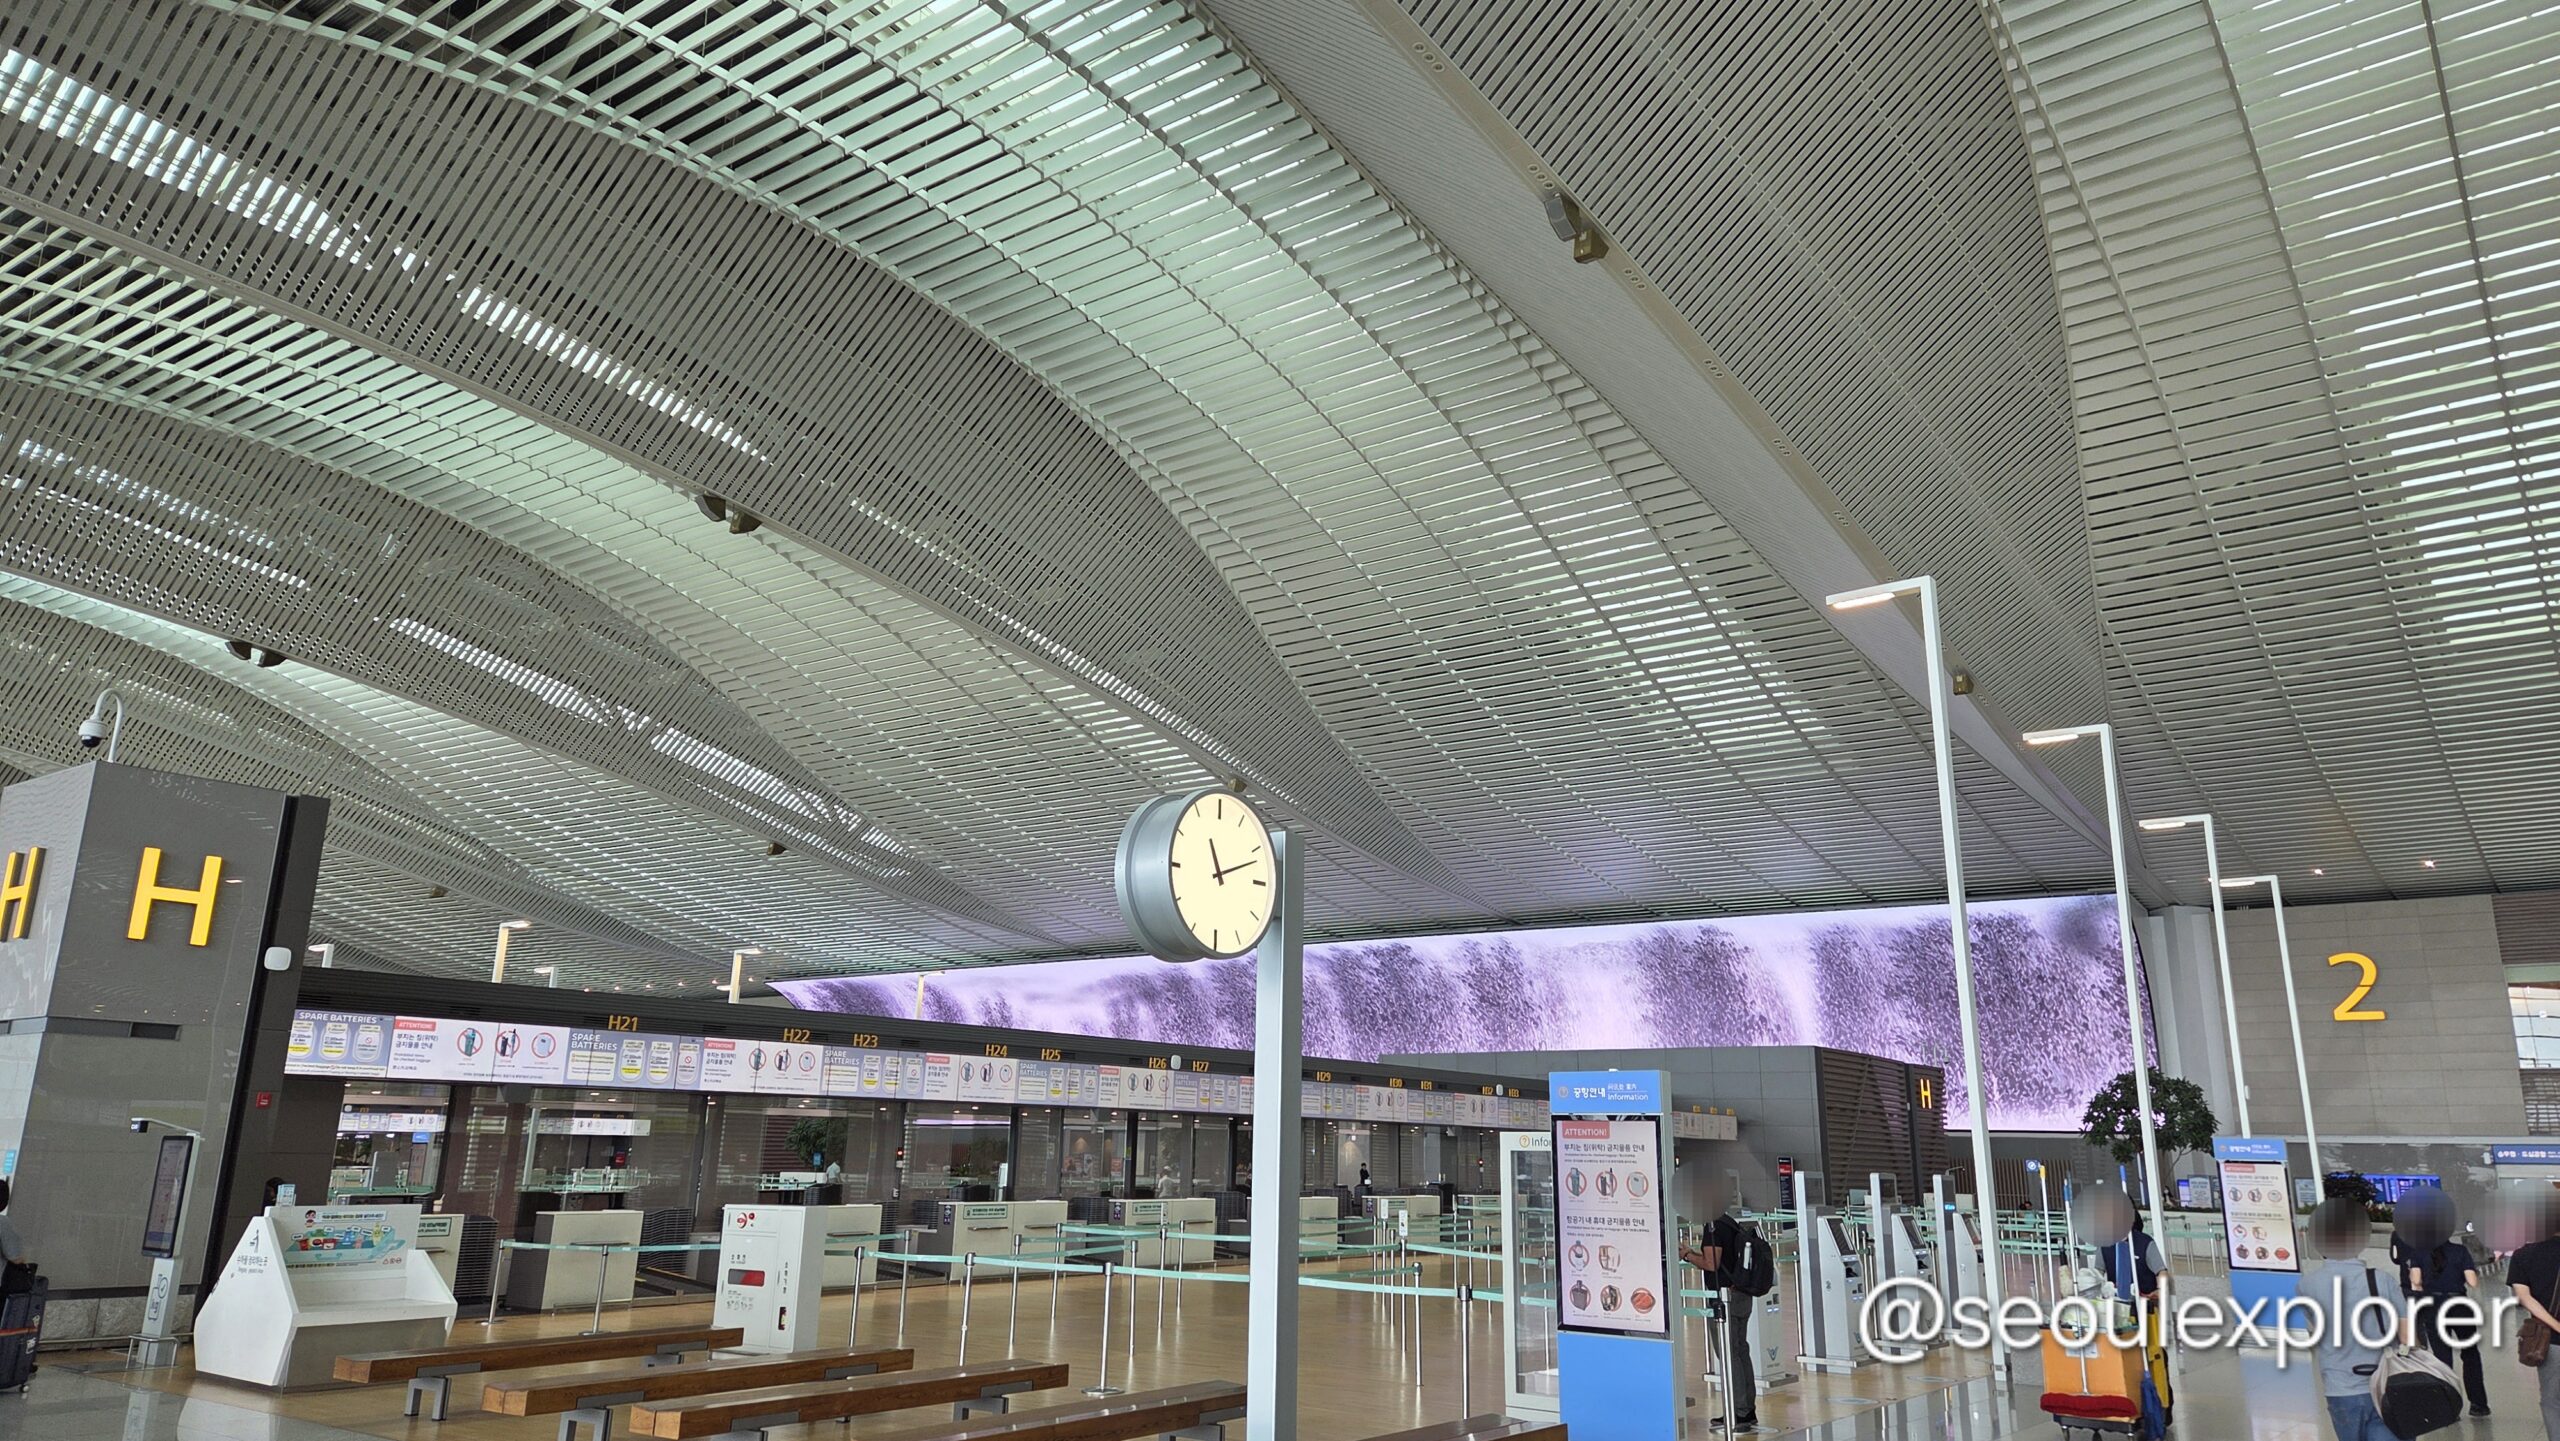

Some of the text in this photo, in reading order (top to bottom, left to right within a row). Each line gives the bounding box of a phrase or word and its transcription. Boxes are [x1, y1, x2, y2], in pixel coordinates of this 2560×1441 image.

[0, 847, 46, 942] H
[127, 847, 222, 946] H
[2328, 952, 2385, 1021] 2
[299, 1012, 377, 1024] SPARE BATTERIES
[608, 1015, 638, 1031] H21
[571, 1032, 600, 1042] SPARE
[783, 1028, 811, 1043] H22
[853, 1033, 878, 1048] H23
[571, 1041, 617, 1051] BATTERIES
[985, 1044, 1008, 1057] H24
[1041, 1048, 1061, 1061] H25
[824, 1057, 860, 1066] BATTERIES
[1149, 1057, 1167, 1069] H26
[1192, 1060, 1209, 1072] H27
[1573, 1087, 1606, 1098] 공항안내
[1607, 1093, 1648, 1101] Information
[1920, 1078, 1932, 1109] H
[1564, 1128, 1607, 1136] ATTENTION!
[1632, 1144, 1645, 1153] 안내
[1632, 1218, 1645, 1226] 안내
